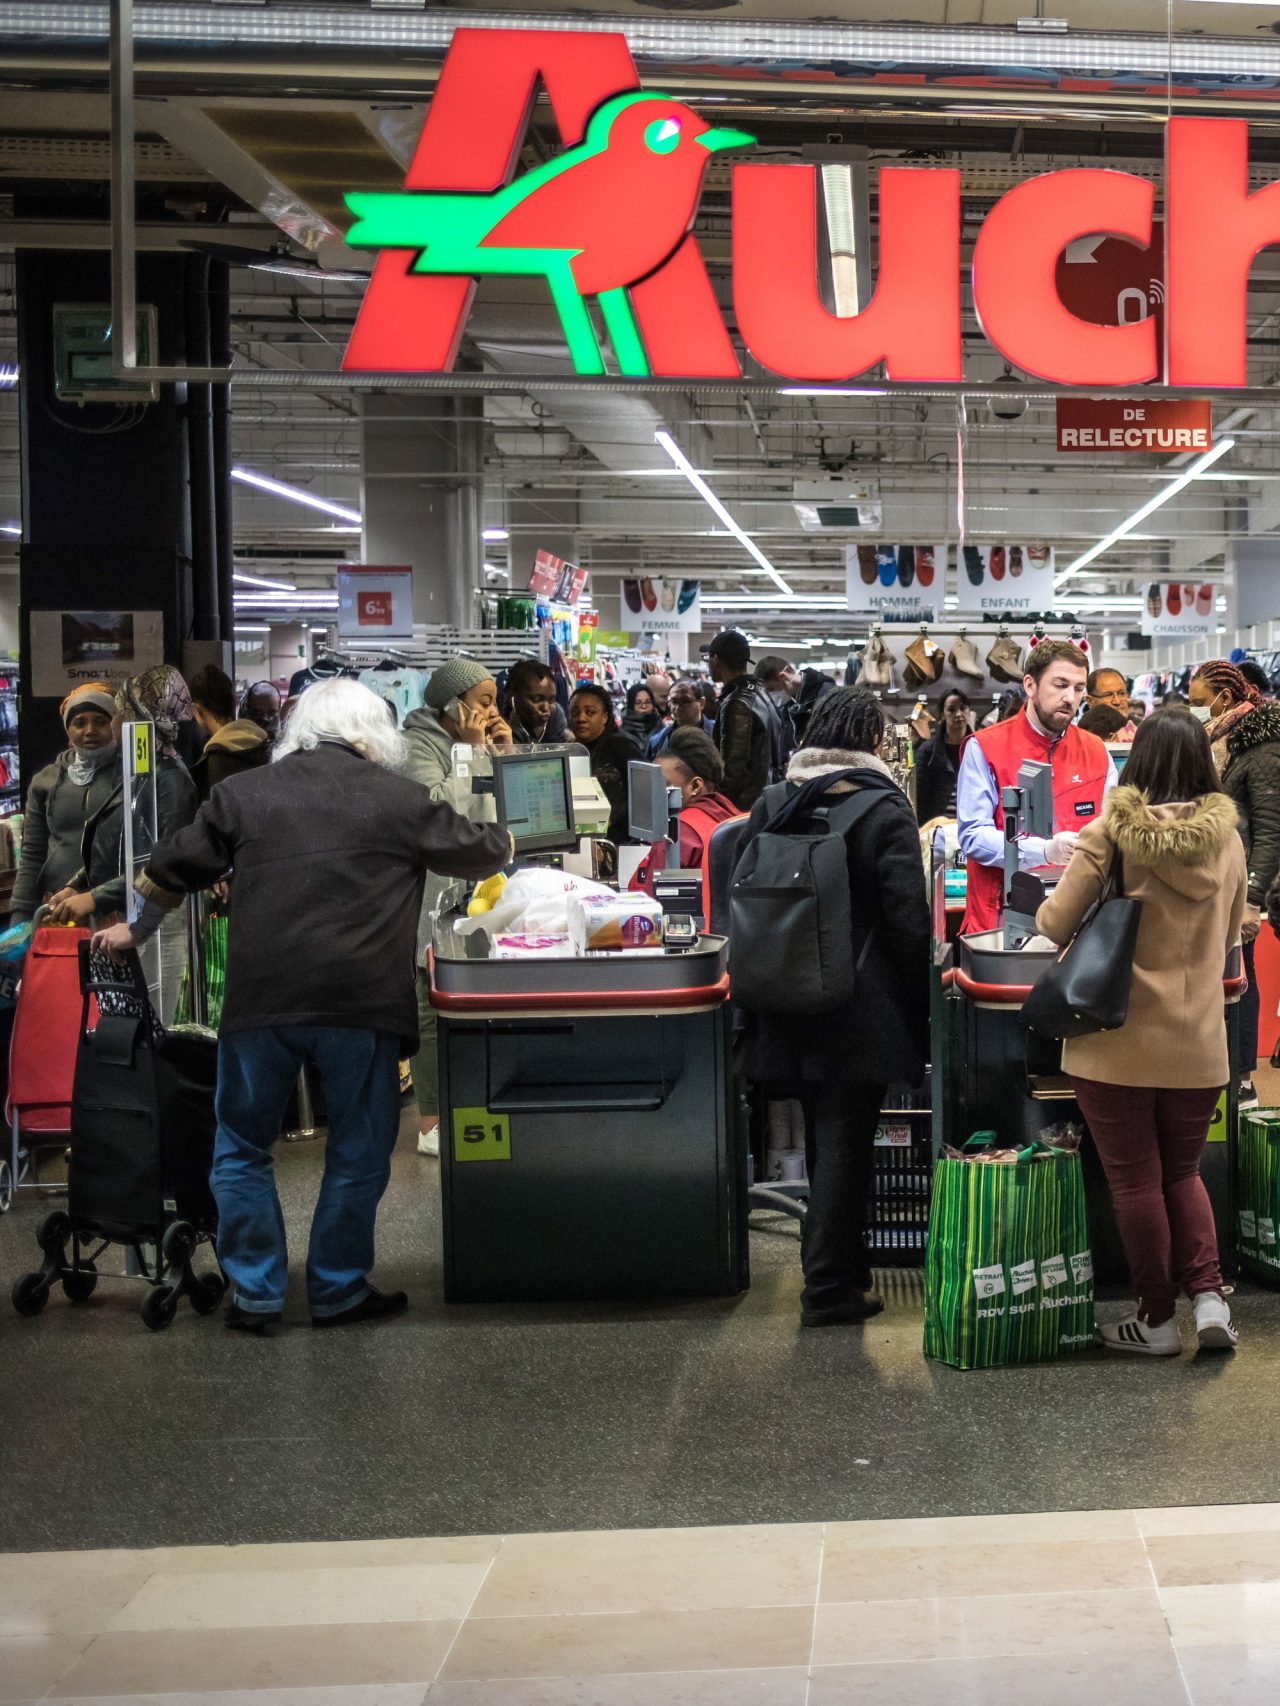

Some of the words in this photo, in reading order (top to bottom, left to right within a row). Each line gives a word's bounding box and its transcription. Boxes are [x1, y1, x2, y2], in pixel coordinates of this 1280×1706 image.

[1123, 409, 1146, 421] DE
[1061, 428, 1207, 447] RELECTURE
[869, 597, 921, 607] HOMME
[981, 598, 1031, 608] ENFANT
[641, 621, 681, 630] FEMME
[1153, 624, 1208, 633] CHAUSSON
[137, 737, 147, 761] 51
[463, 1123, 504, 1144] 51
[977, 1306, 1006, 1319] RDV
[1009, 1302, 1035, 1315] SUR
[1059, 1333, 1093, 1345] Auchan
